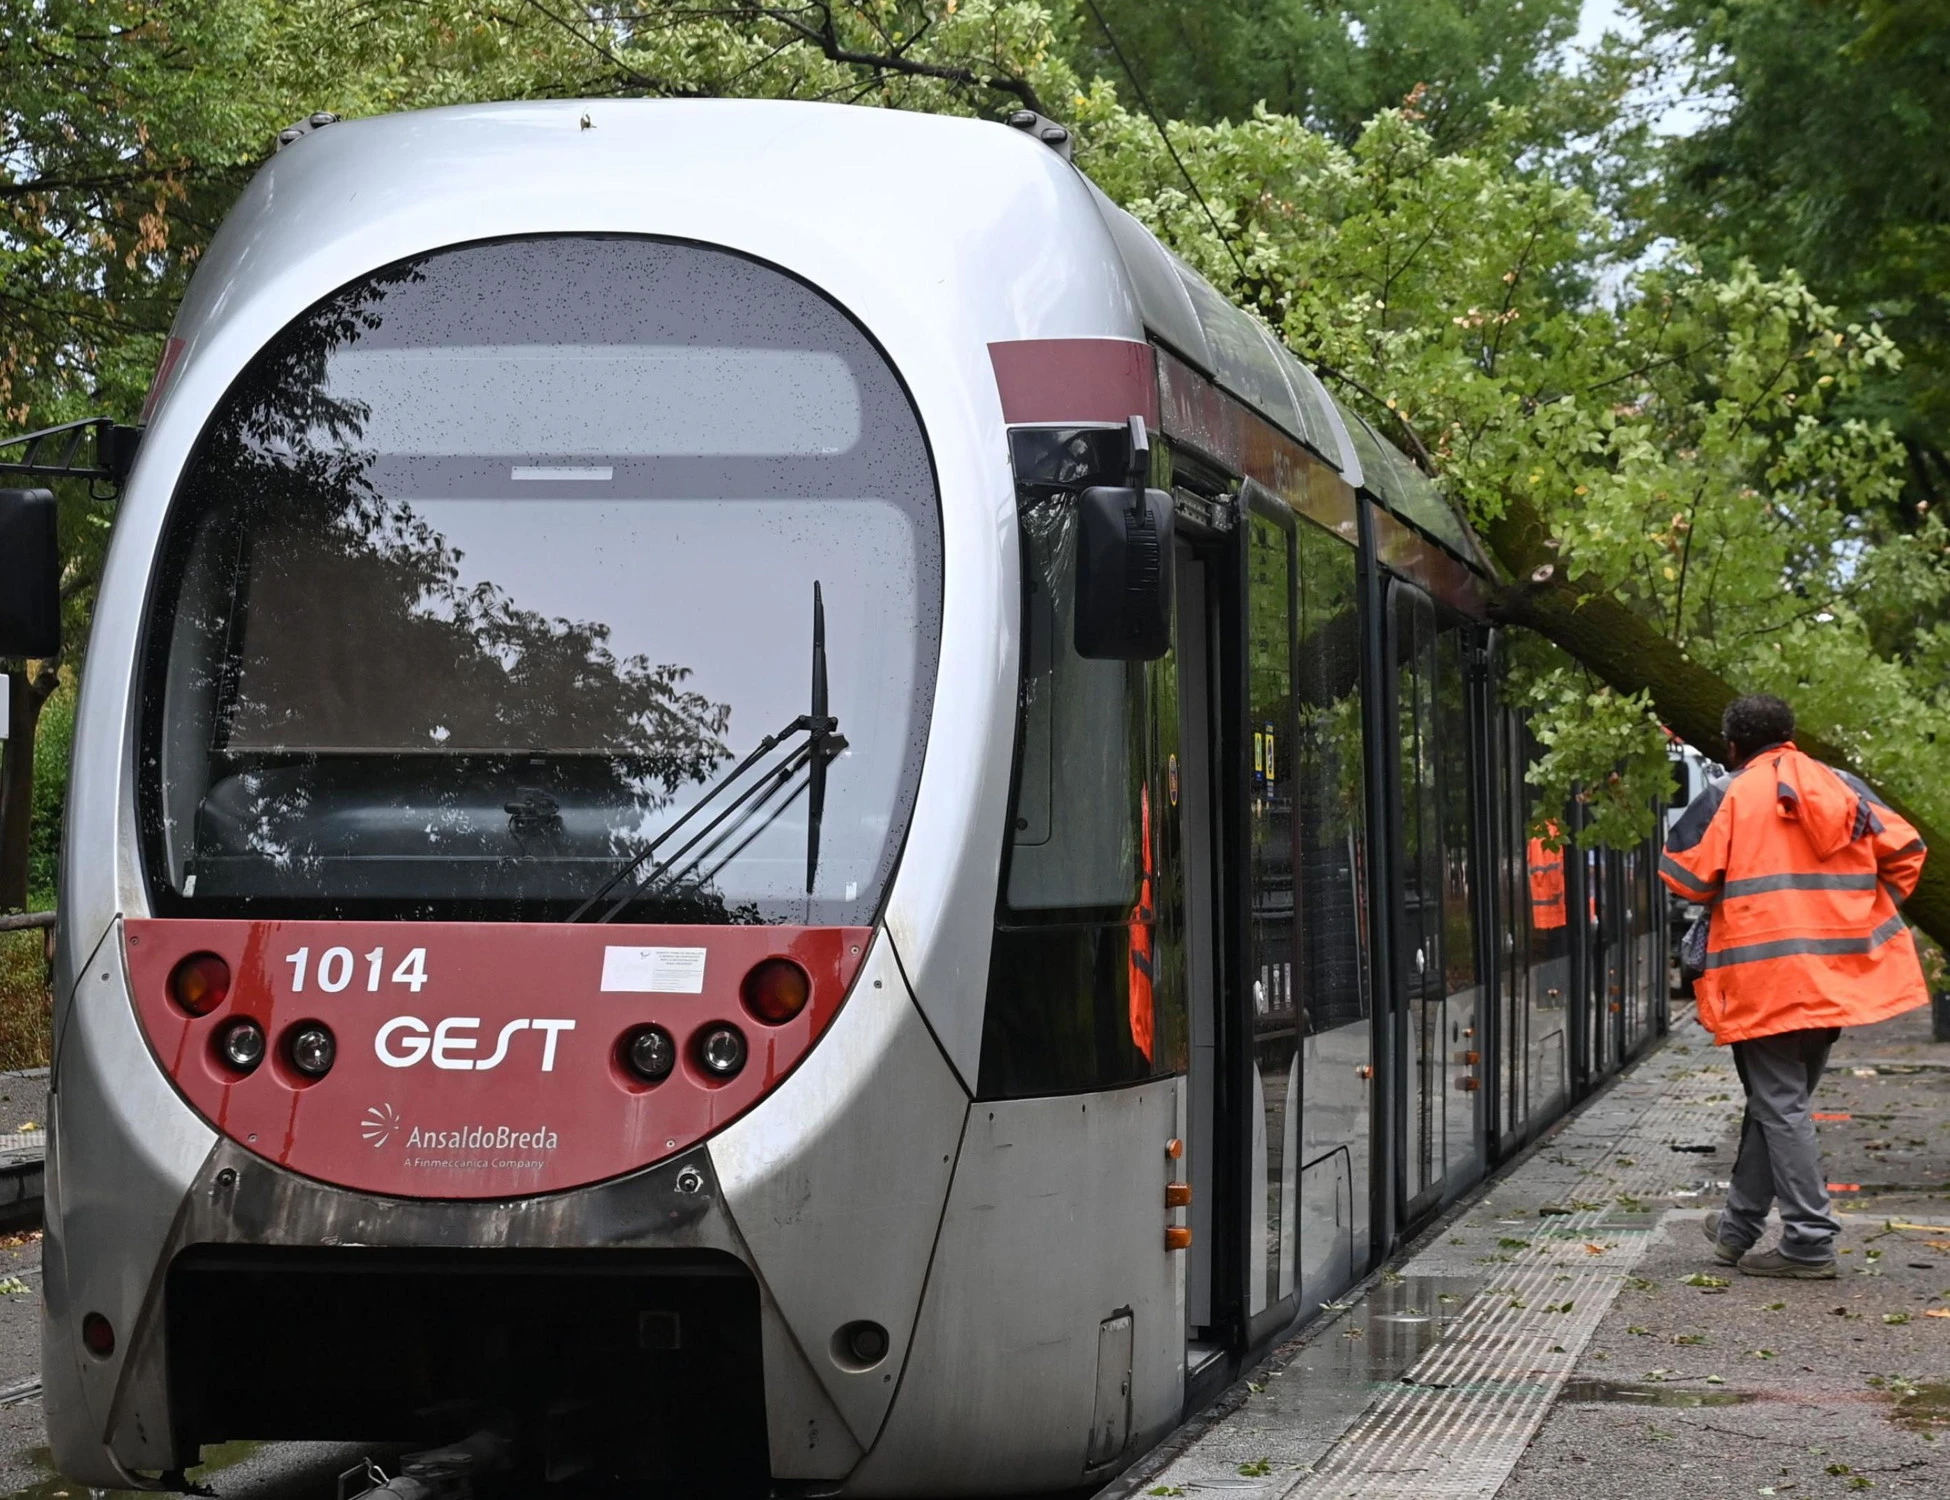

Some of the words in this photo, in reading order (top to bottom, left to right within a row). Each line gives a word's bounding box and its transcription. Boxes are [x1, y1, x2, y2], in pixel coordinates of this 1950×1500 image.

[285, 946, 428, 993] 1014
[374, 1015, 576, 1072] GEST
[405, 1125, 558, 1149] AnsaldoBreda
[403, 1158, 412, 1167] A
[414, 1157, 488, 1168] Finmeccanica
[491, 1158, 544, 1169] Company
